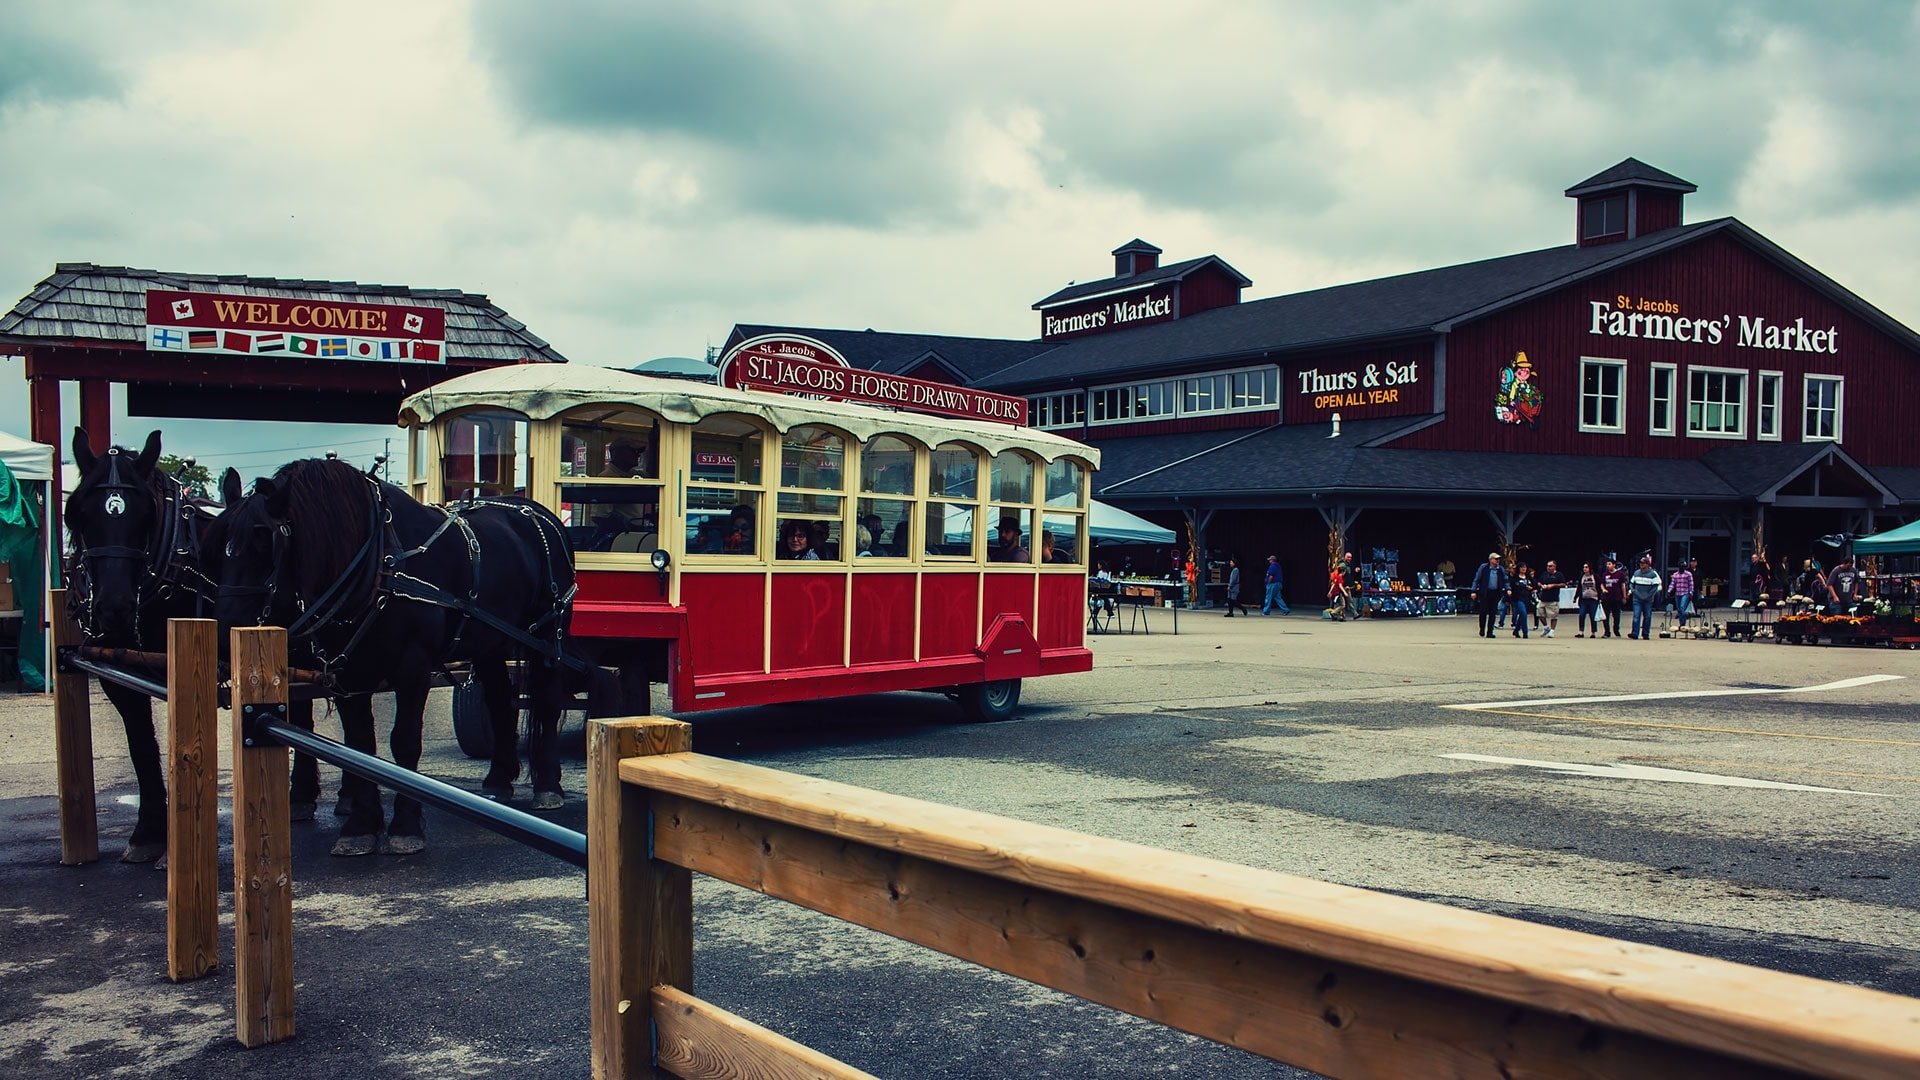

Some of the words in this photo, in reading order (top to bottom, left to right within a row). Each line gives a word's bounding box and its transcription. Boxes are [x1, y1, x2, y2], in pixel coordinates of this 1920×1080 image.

[213, 300, 387, 331] WELCOME!
[1045, 304, 1111, 336] Farmers’
[1113, 294, 1171, 322] Market
[1617, 295, 1633, 310] St.
[1637, 297, 1679, 314] Jacobs
[1589, 300, 1730, 344] Farmers’
[1737, 315, 1838, 354] Market
[760, 344, 775, 354] St.
[779, 343, 816, 358] Jacobs
[748, 356, 772, 380] ST.
[774, 361, 845, 391] JACOBS
[850, 374, 909, 402] HORSE
[912, 384, 971, 411] DRAWN
[974, 395, 1020, 420] TOURS
[1299, 368, 1357, 394] Thurs
[1363, 363, 1381, 388] &
[1385, 360, 1418, 386] Sat
[1314, 394, 1343, 409] OPEN
[1345, 391, 1366, 407] ALL
[1368, 388, 1398, 404] YEAR
[702, 455, 715, 463] ST.
